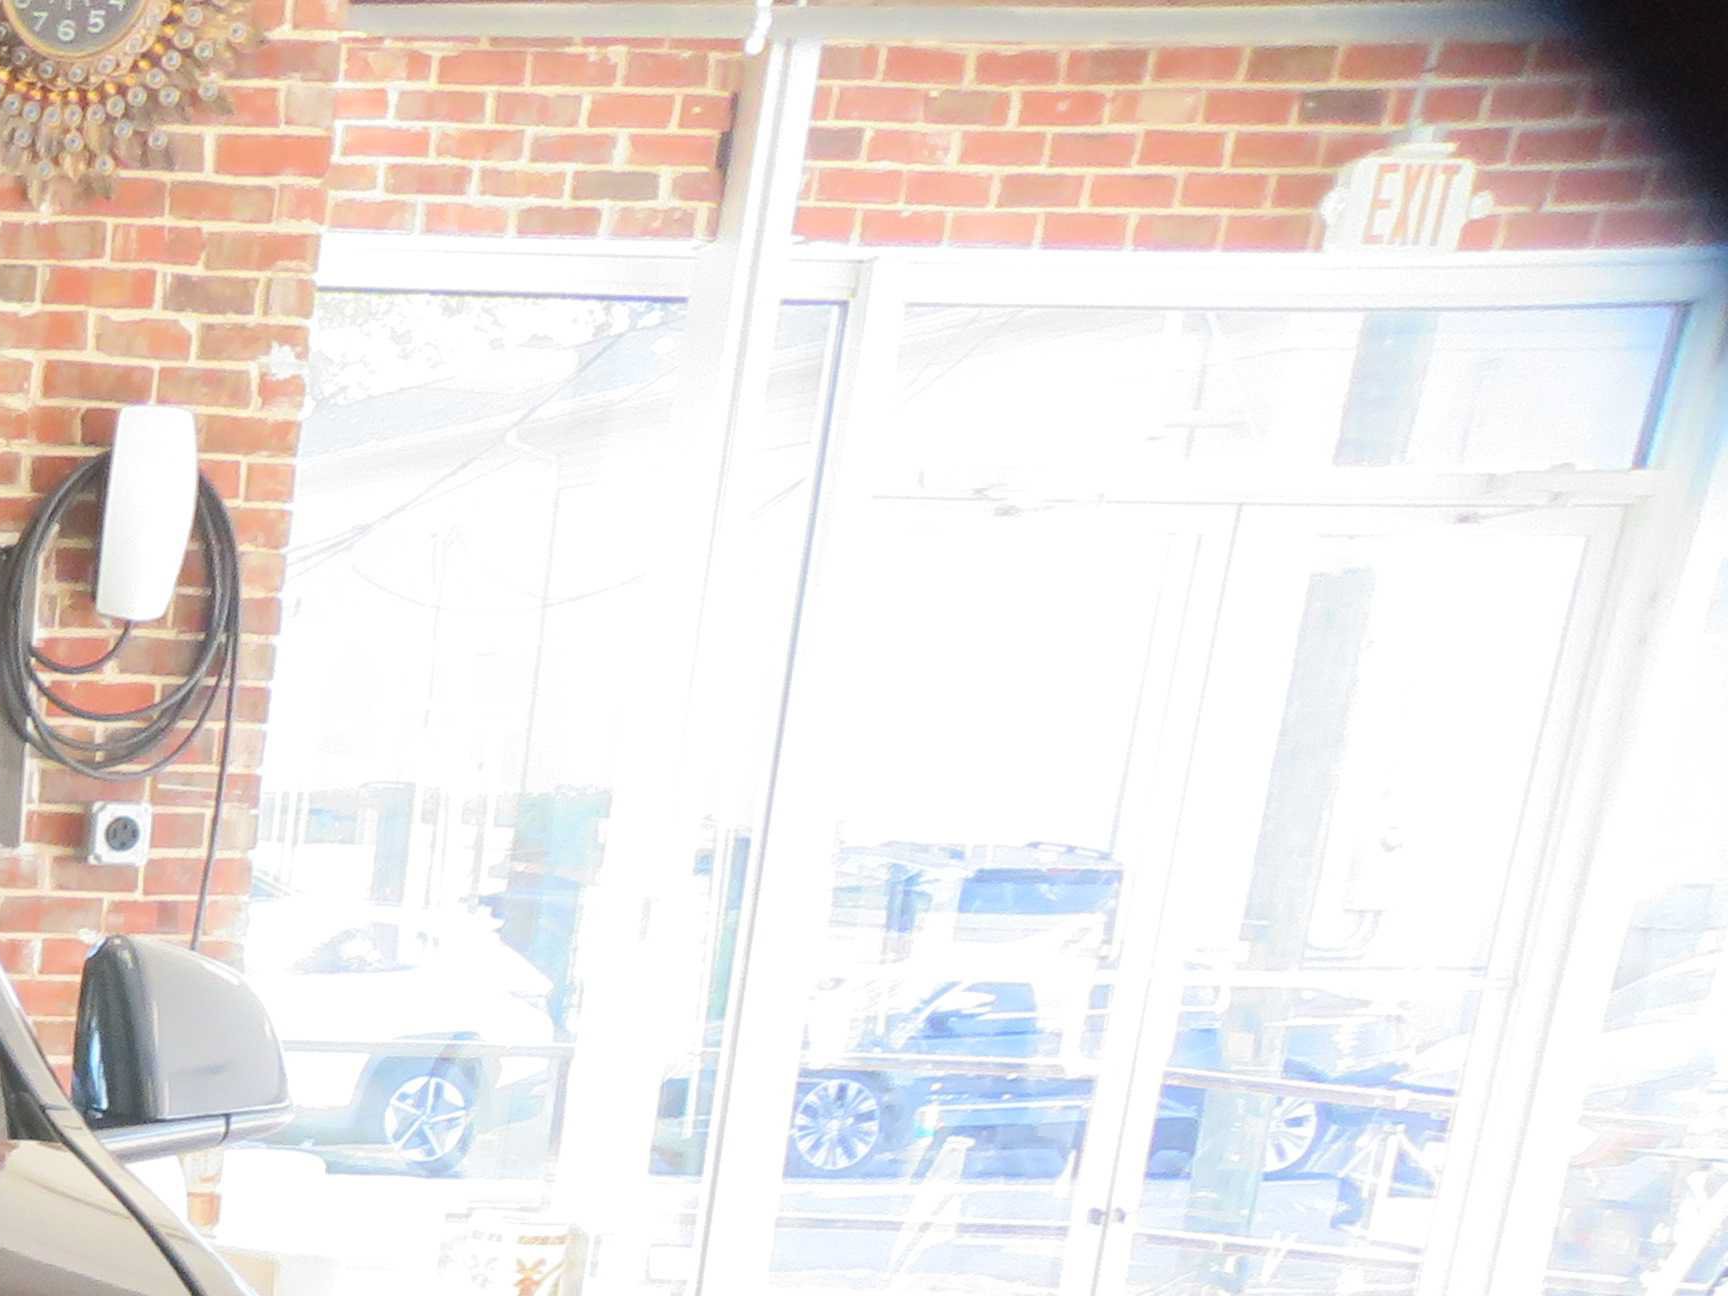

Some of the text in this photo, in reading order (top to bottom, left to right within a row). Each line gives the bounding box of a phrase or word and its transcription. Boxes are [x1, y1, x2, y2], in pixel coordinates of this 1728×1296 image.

[32, 11, 49, 32] 7
[57, 19, 76, 41] 6
[87, 9, 106, 34] 5
[1360, 163, 1462, 246] EXIT
